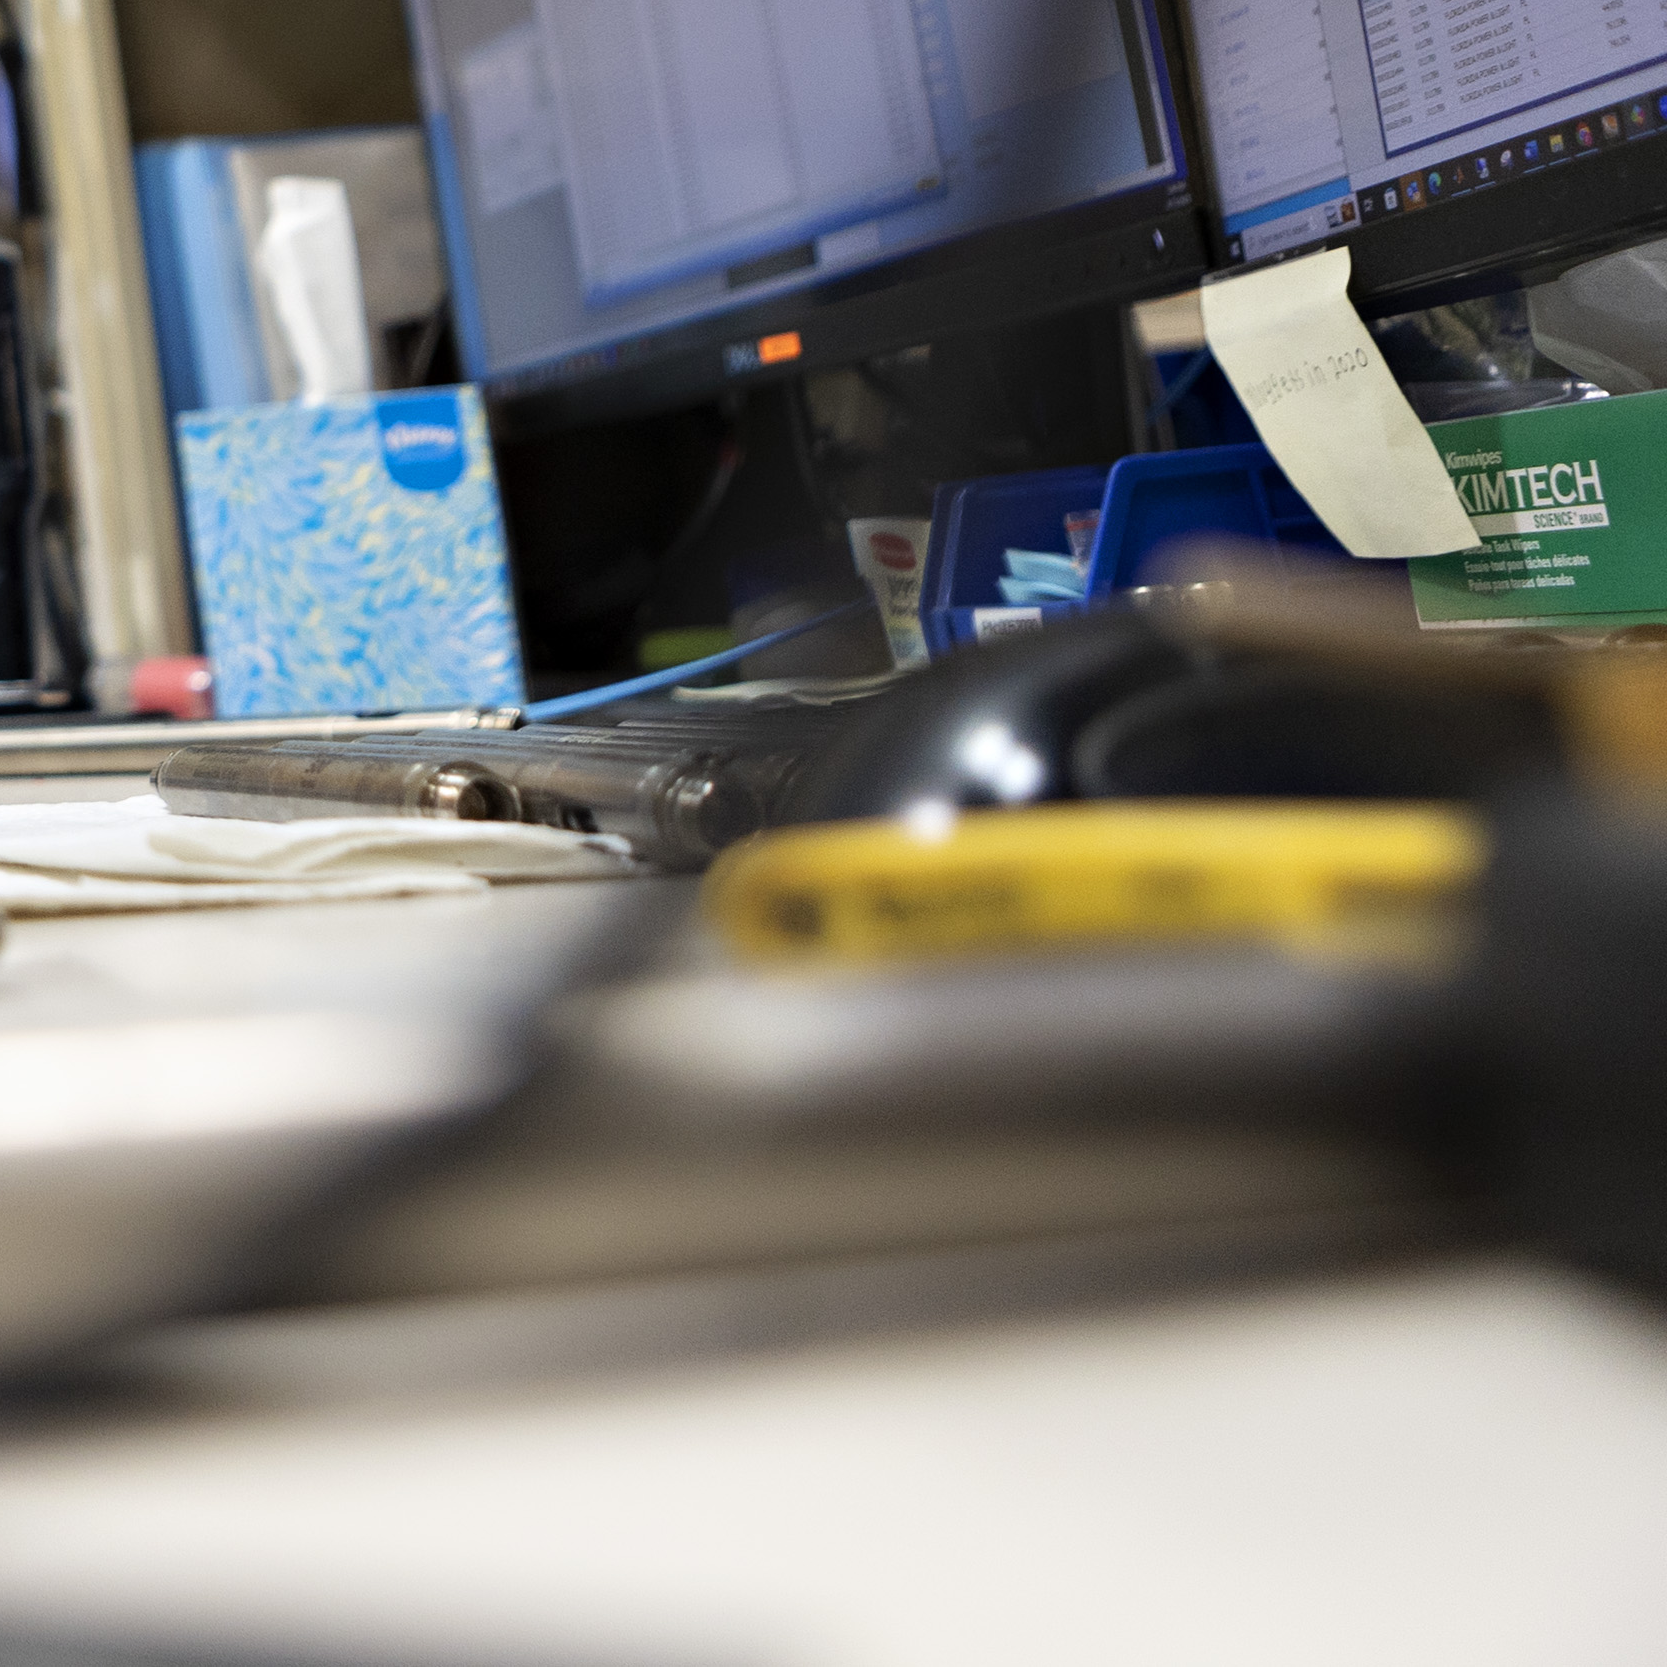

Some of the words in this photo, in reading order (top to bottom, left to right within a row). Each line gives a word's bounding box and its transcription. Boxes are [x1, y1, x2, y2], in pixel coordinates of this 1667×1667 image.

[1327, 347, 1370, 381] 2020
[1445, 448, 1502, 469] Kimwipes
[1450, 459, 1605, 514] KIMTECH
[1533, 511, 1575, 528] SCIENCE
[1579, 512, 1605, 525] BRAND
[1510, 538, 1541, 554] Wipers
